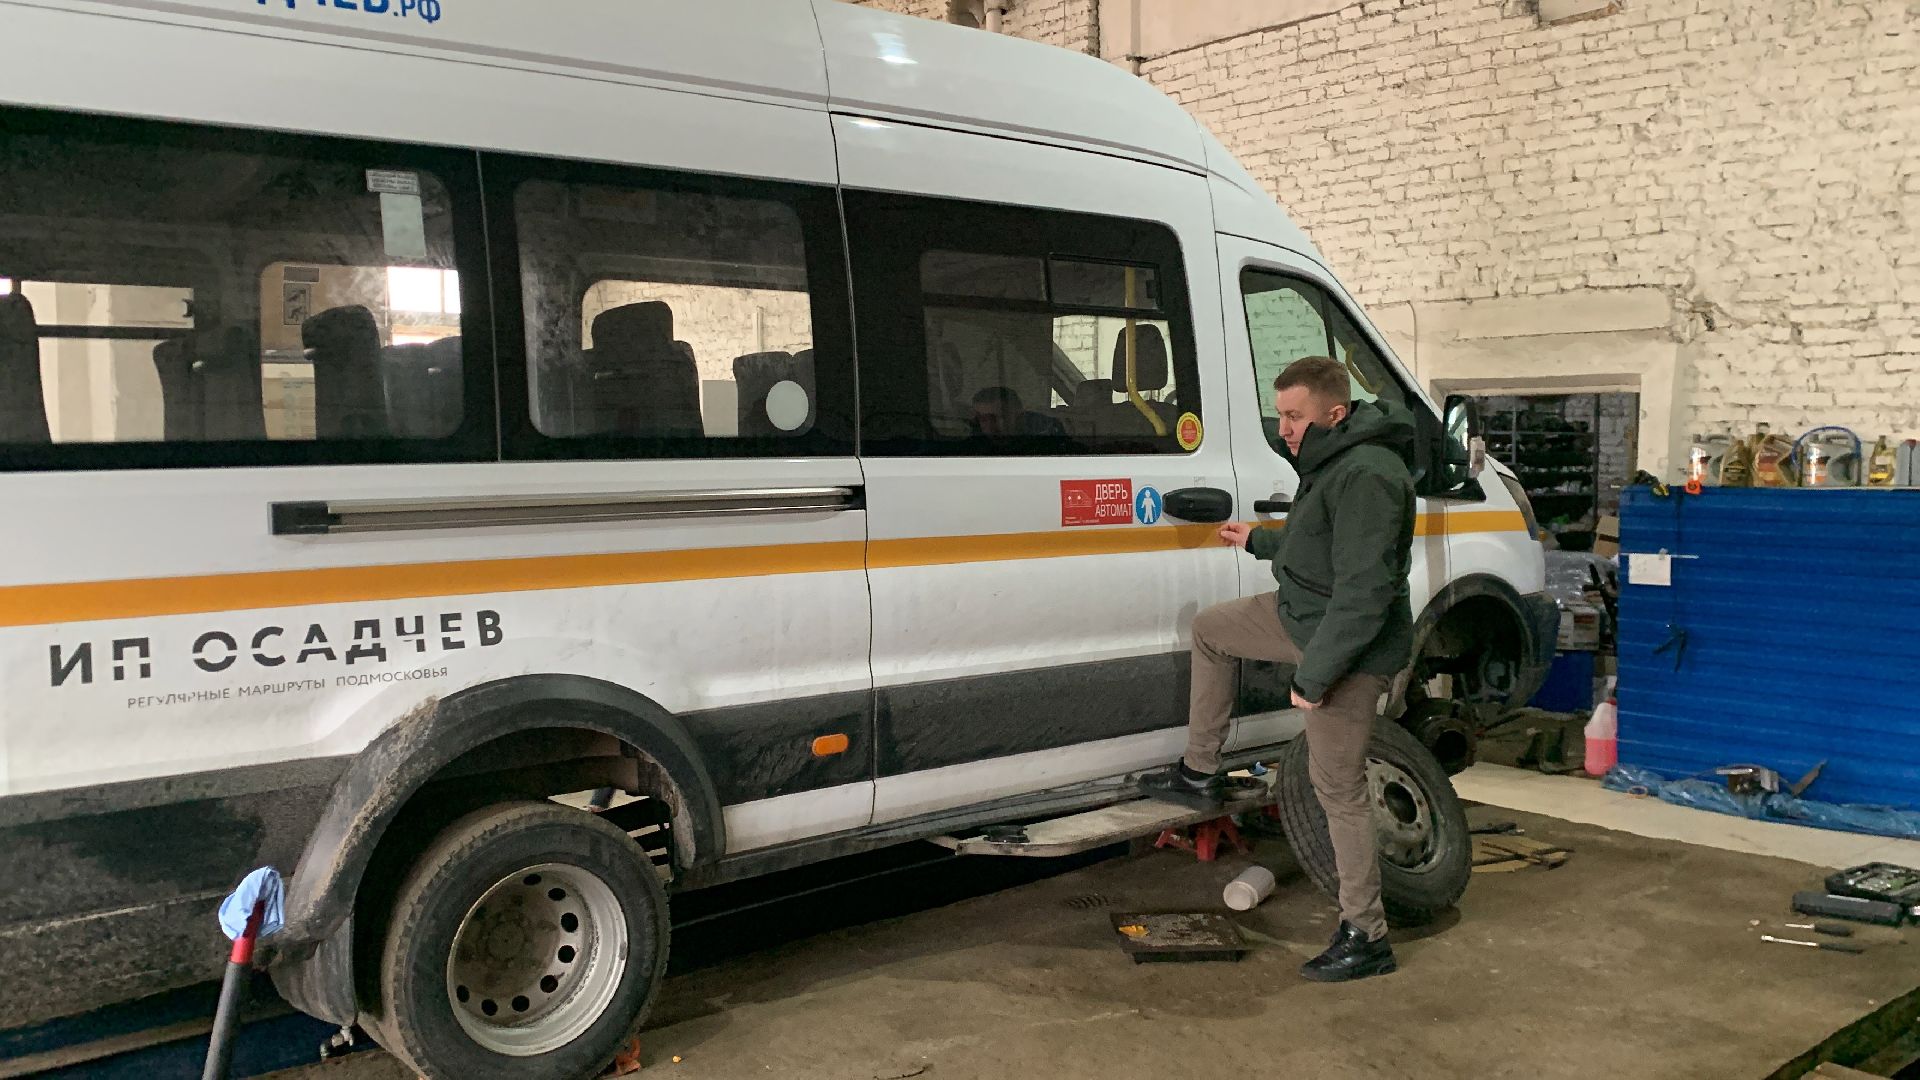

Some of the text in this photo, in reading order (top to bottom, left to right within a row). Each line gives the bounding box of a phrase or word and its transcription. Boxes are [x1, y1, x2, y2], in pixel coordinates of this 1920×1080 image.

[1095, 483, 1128, 503] ДВЕРЬ
[1095, 504, 1133, 517] АВТОМАТ
[49, 609, 503, 686] ИП ОСАДЧЕВ
[238, 679, 325, 696] МАРШРУТЫ
[336, 667, 448, 687] ПОДМОСКОВЬЯ
